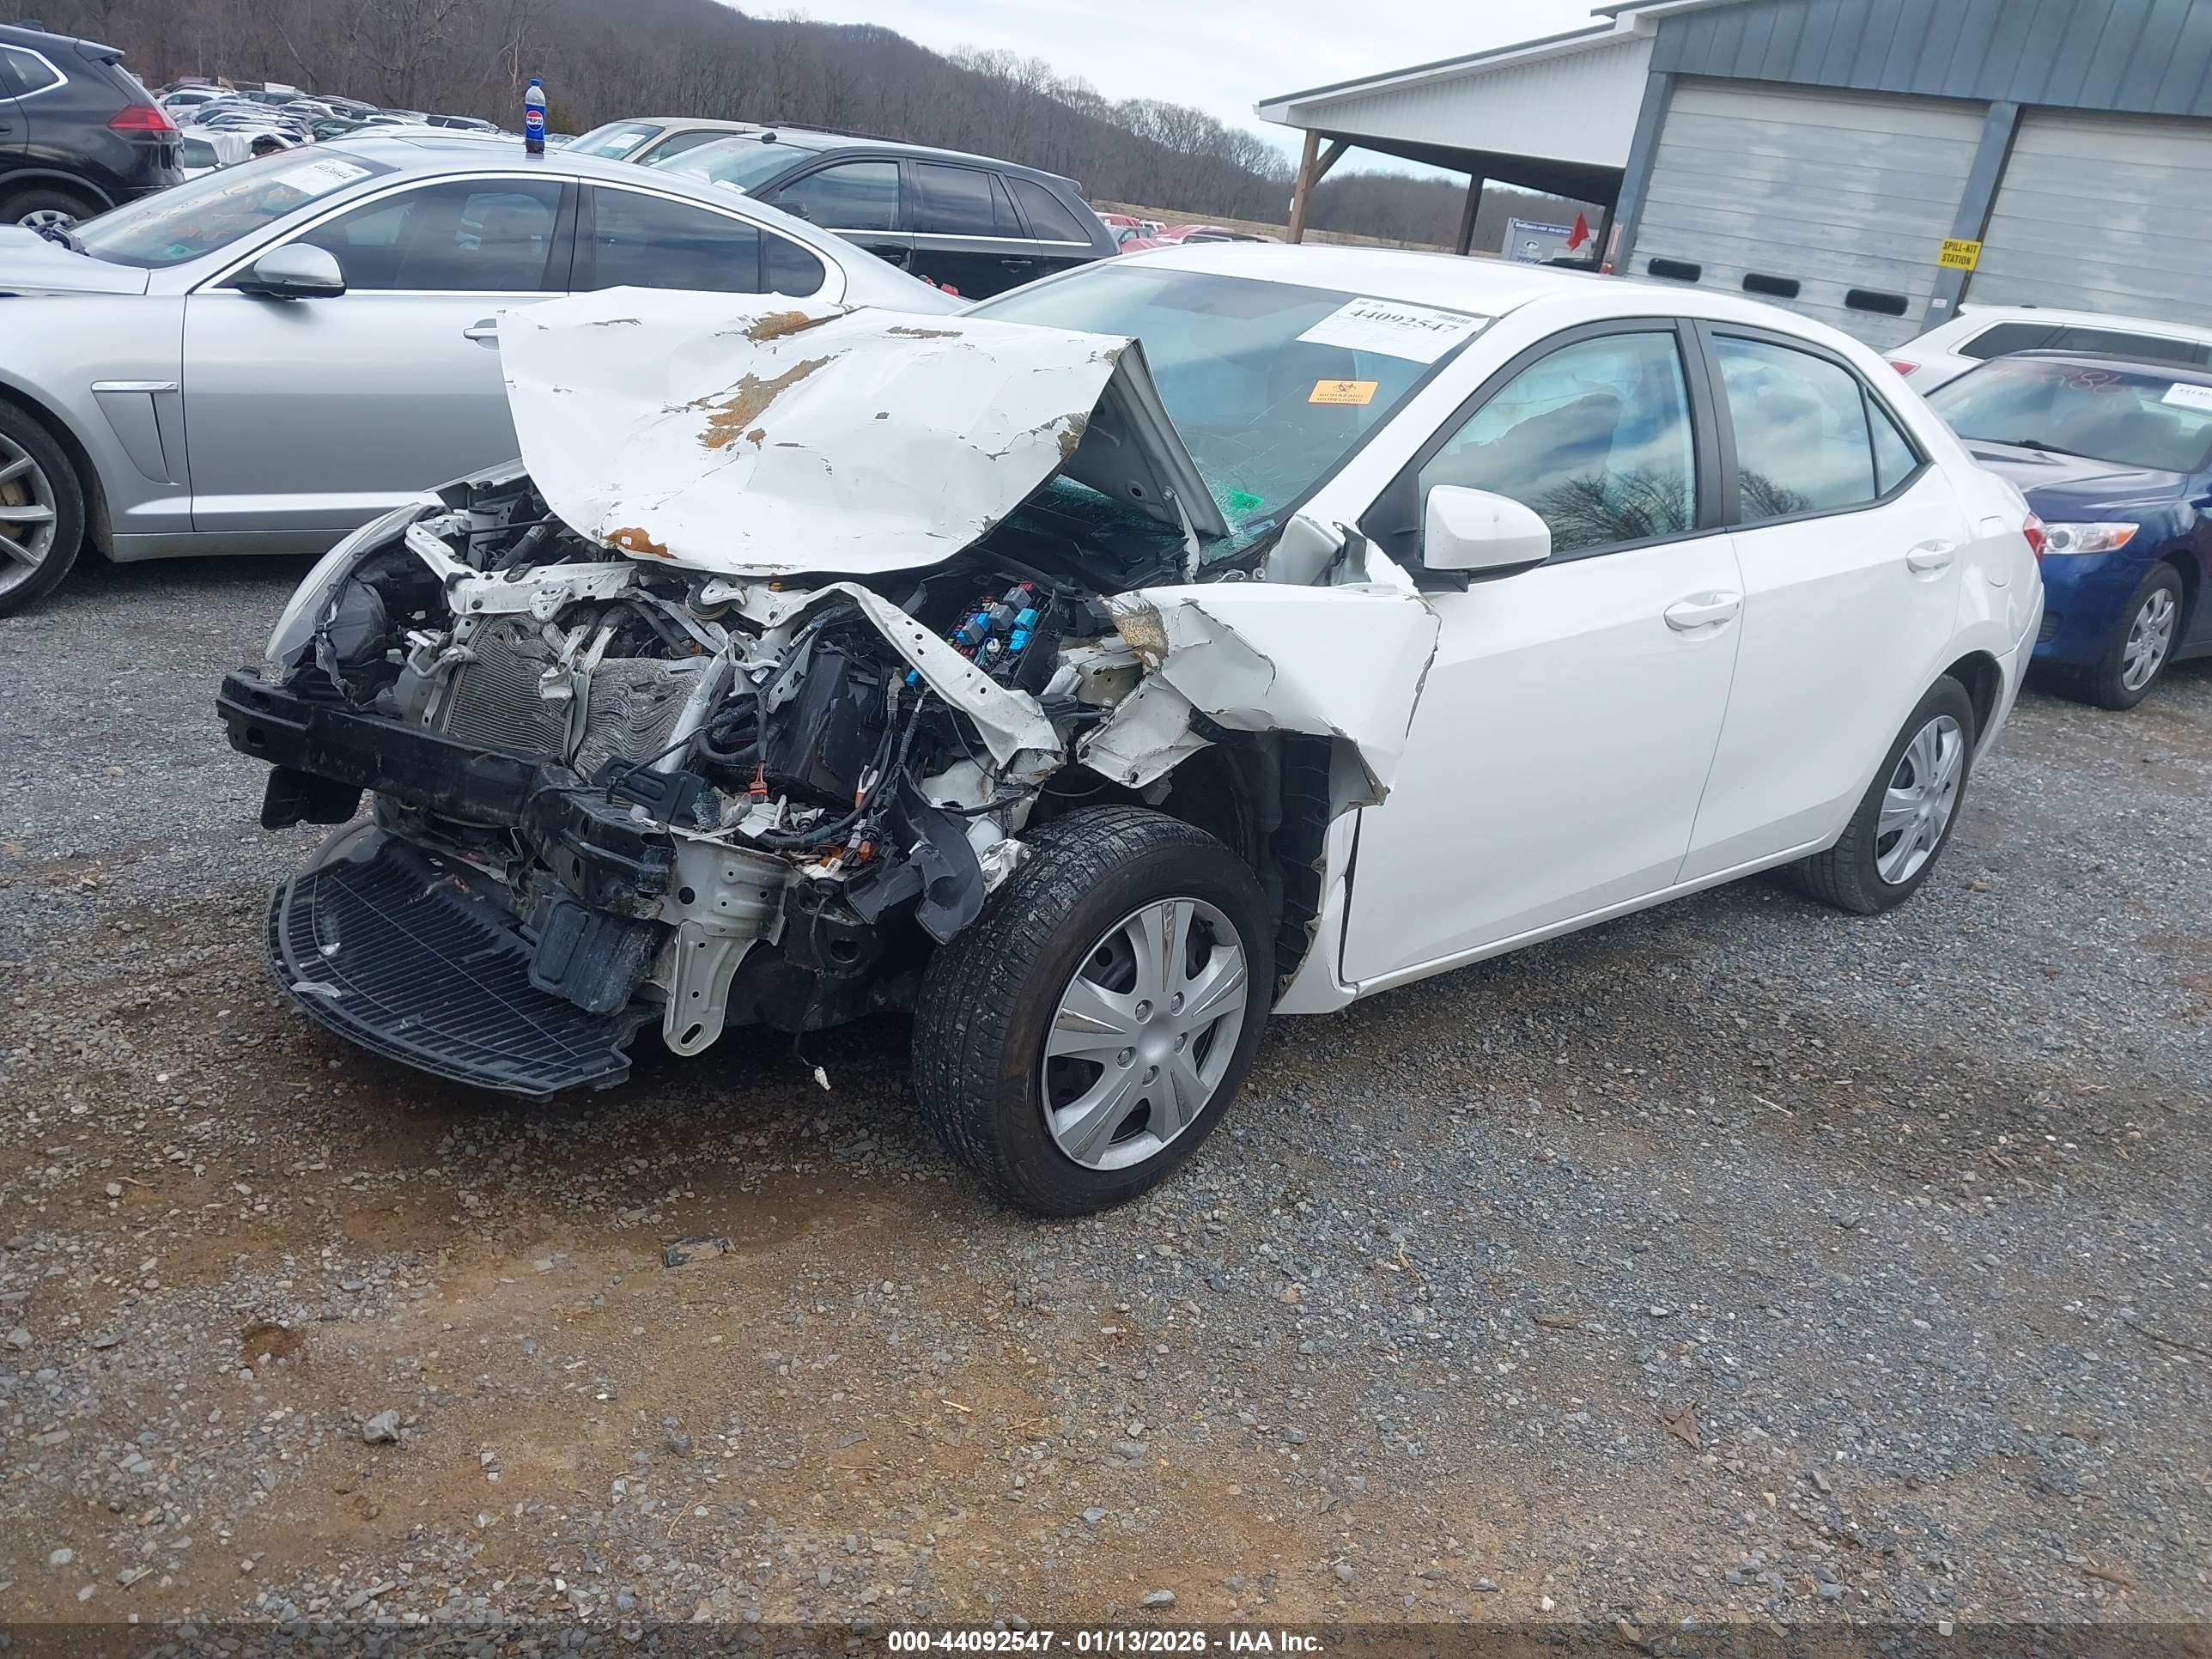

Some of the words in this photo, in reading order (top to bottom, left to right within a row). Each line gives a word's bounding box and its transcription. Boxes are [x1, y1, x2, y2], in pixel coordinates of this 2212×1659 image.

[1942, 240, 1978, 253] SPILL-KIT
[1942, 253, 1972, 265] STATION
[1349, 308, 1460, 334] 44092547
